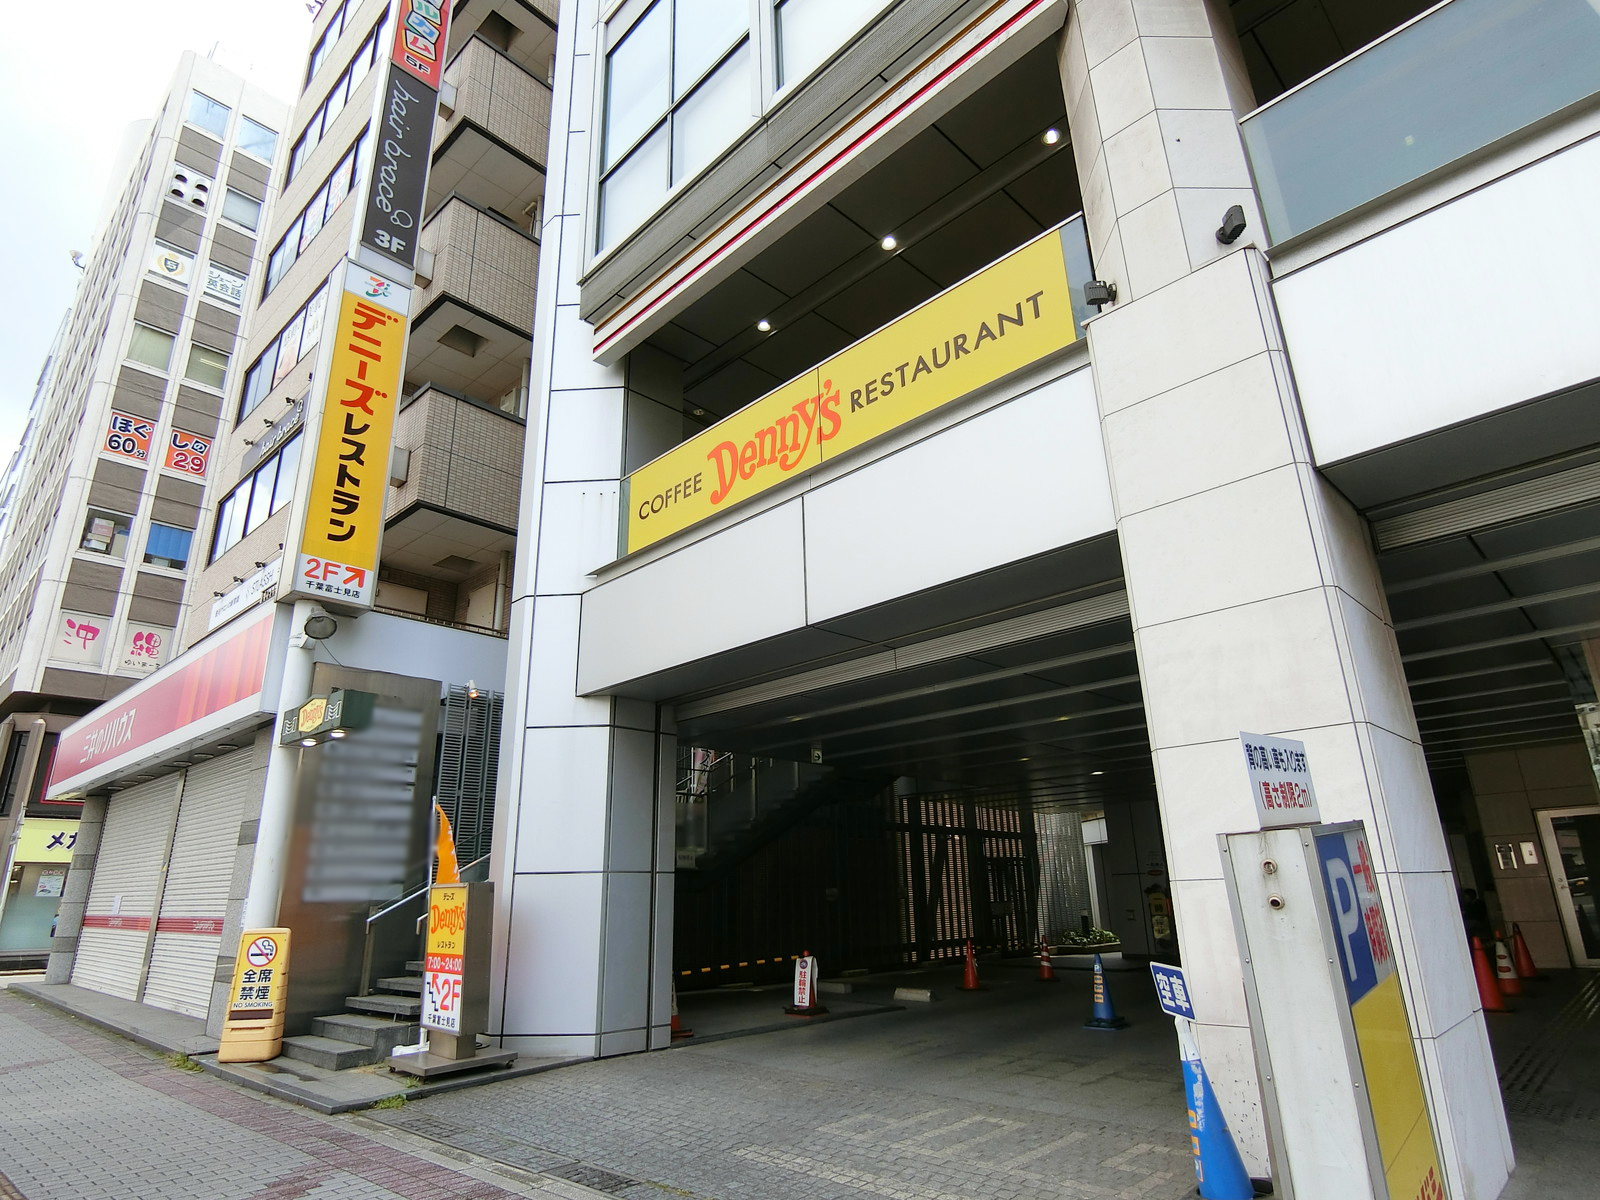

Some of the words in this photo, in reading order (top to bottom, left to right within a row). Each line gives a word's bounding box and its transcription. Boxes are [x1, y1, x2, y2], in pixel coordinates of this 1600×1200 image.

[405, 54, 430, 74] 5F
[388, 79, 420, 139] hair
[375, 139, 412, 214] brace
[374, 229, 407, 253] 3F
[207, 278, 242, 298] 英会話
[638, 471, 702, 521] COFFEE
[706, 379, 842, 506] Denny's
[849, 289, 1046, 413] RESTAURANT
[107, 433, 146, 458] 60分
[173, 452, 205, 473] 29
[304, 558, 341, 582] 2F
[305, 580, 361, 599] 千葉富士見店
[79, 708, 137, 764] 三井のリハウス
[1244, 742, 1307, 773] 背の高い車も入ります
[430, 902, 466, 936] Denny's
[1325, 857, 1359, 982] P
[242, 969, 274, 983] 全席
[798, 970, 808, 1004] 駐輪禁止
[239, 985, 271, 1000] 禁煙
[440, 978, 463, 1012] 2F
[1155, 972, 1190, 1012] 空車
